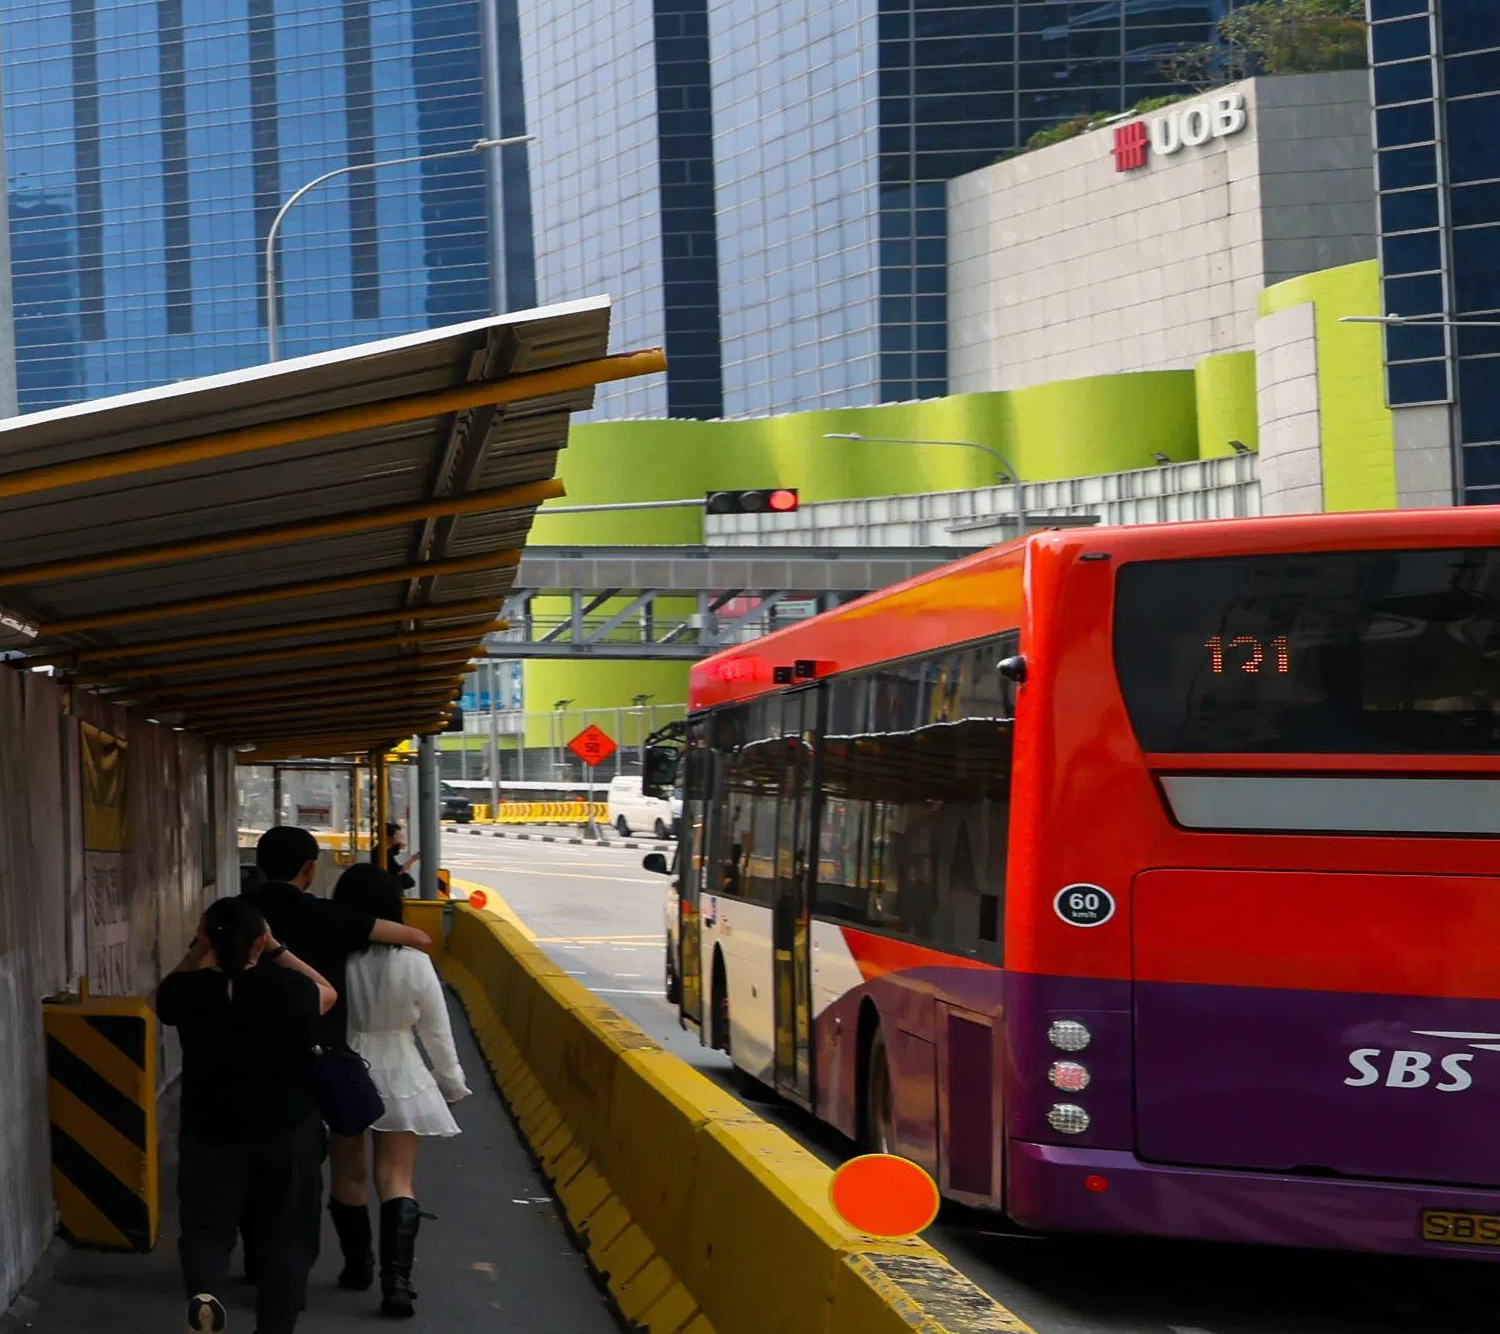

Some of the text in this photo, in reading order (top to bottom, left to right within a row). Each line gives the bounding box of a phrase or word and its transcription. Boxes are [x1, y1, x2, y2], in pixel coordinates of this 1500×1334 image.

[1150, 91, 1247, 157] UOB
[1205, 634, 1291, 675] 121
[1069, 892, 1100, 912] 60
[1072, 910, 1097, 920] km/h
[1343, 1048, 1475, 1092] SBS
